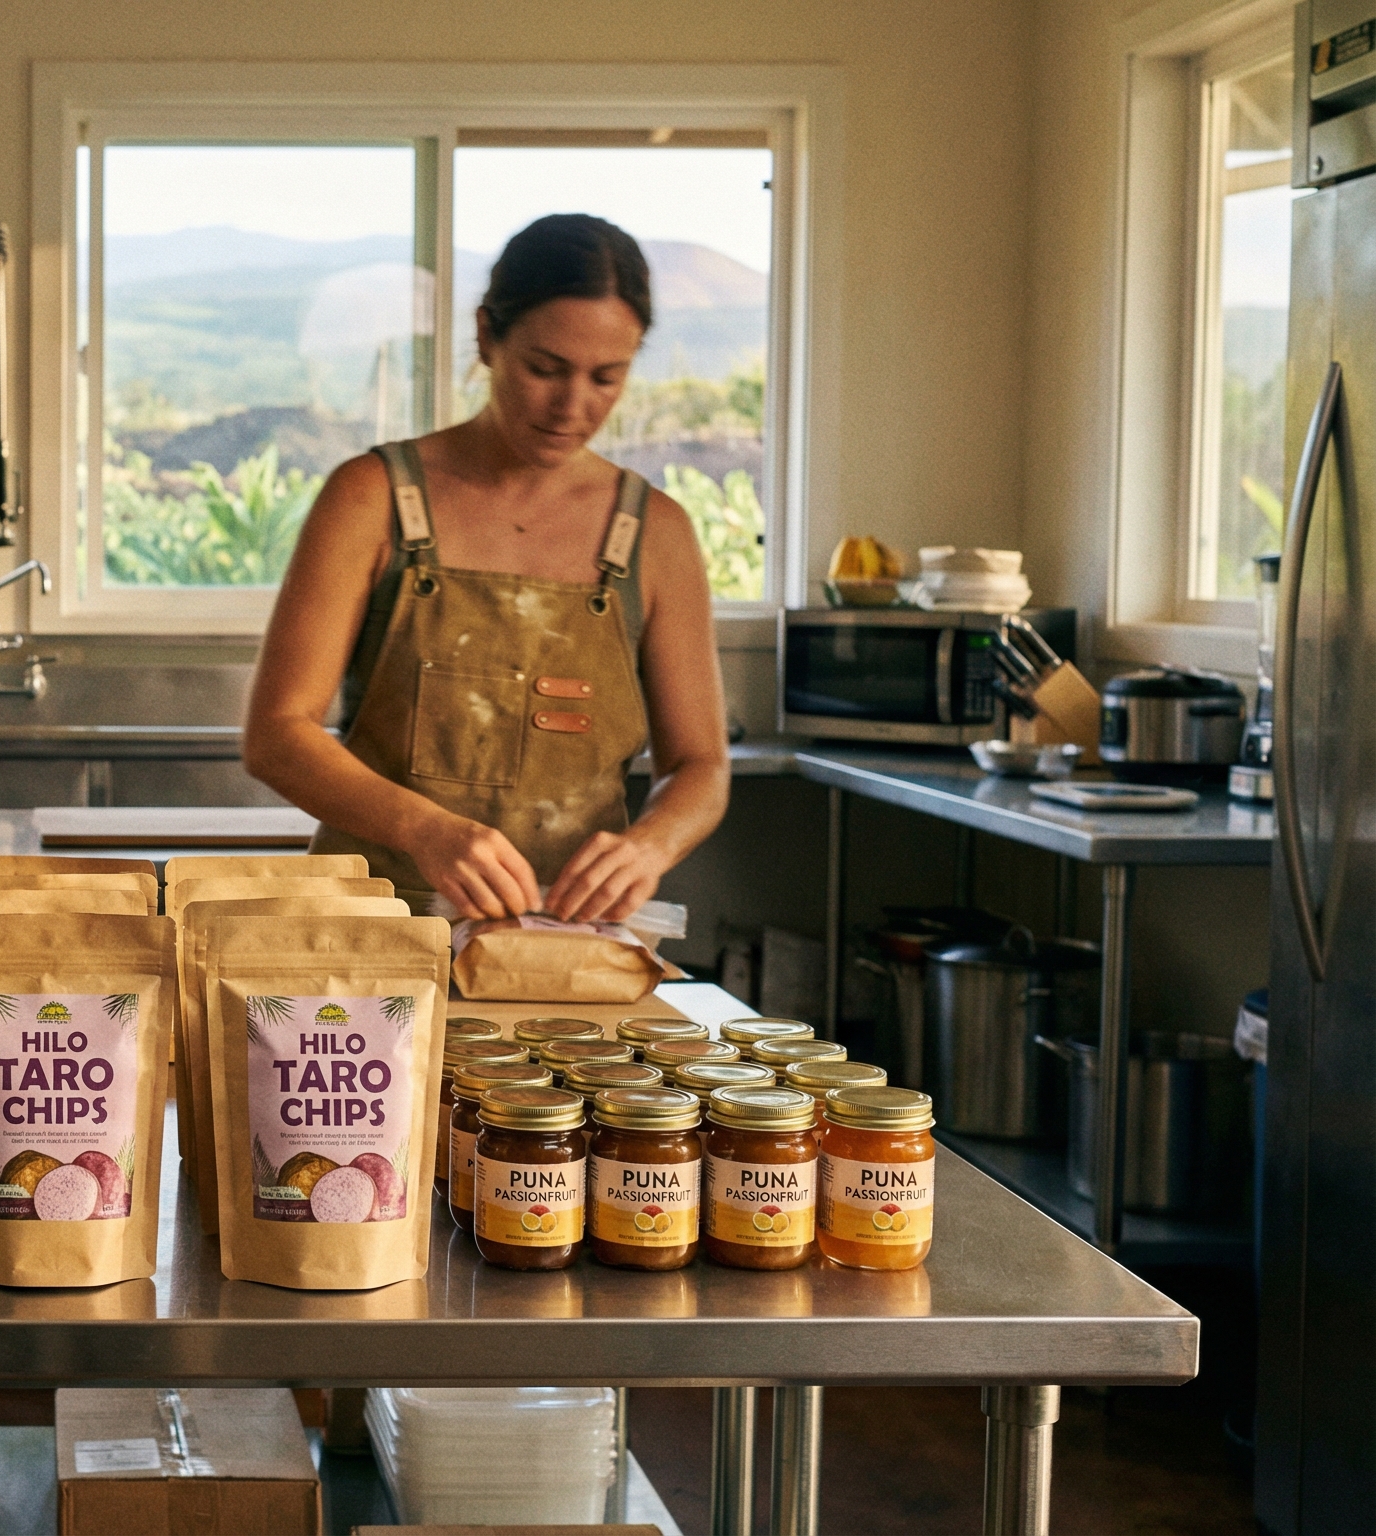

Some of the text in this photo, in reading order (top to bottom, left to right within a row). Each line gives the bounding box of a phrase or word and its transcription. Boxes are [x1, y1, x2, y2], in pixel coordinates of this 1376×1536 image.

[21, 1031, 88, 1053] HILO
[299, 1033, 366, 1055] HILO
[272, 1059, 392, 1093] TARO
[2, 1096, 108, 1125] CHIPS
[280, 1097, 386, 1127] CHIPS
[510, 1170, 566, 1188] PUNA
[623, 1169, 680, 1188] PUNA
[741, 1170, 798, 1188] PUNA
[861, 1169, 917, 1187] PUNA
[607, 1187, 691, 1203] PASSIONFRUIT
[726, 1187, 809, 1203] PASSIONFRUIT
[845, 1186, 927, 1202] PASSIONFRUIT
